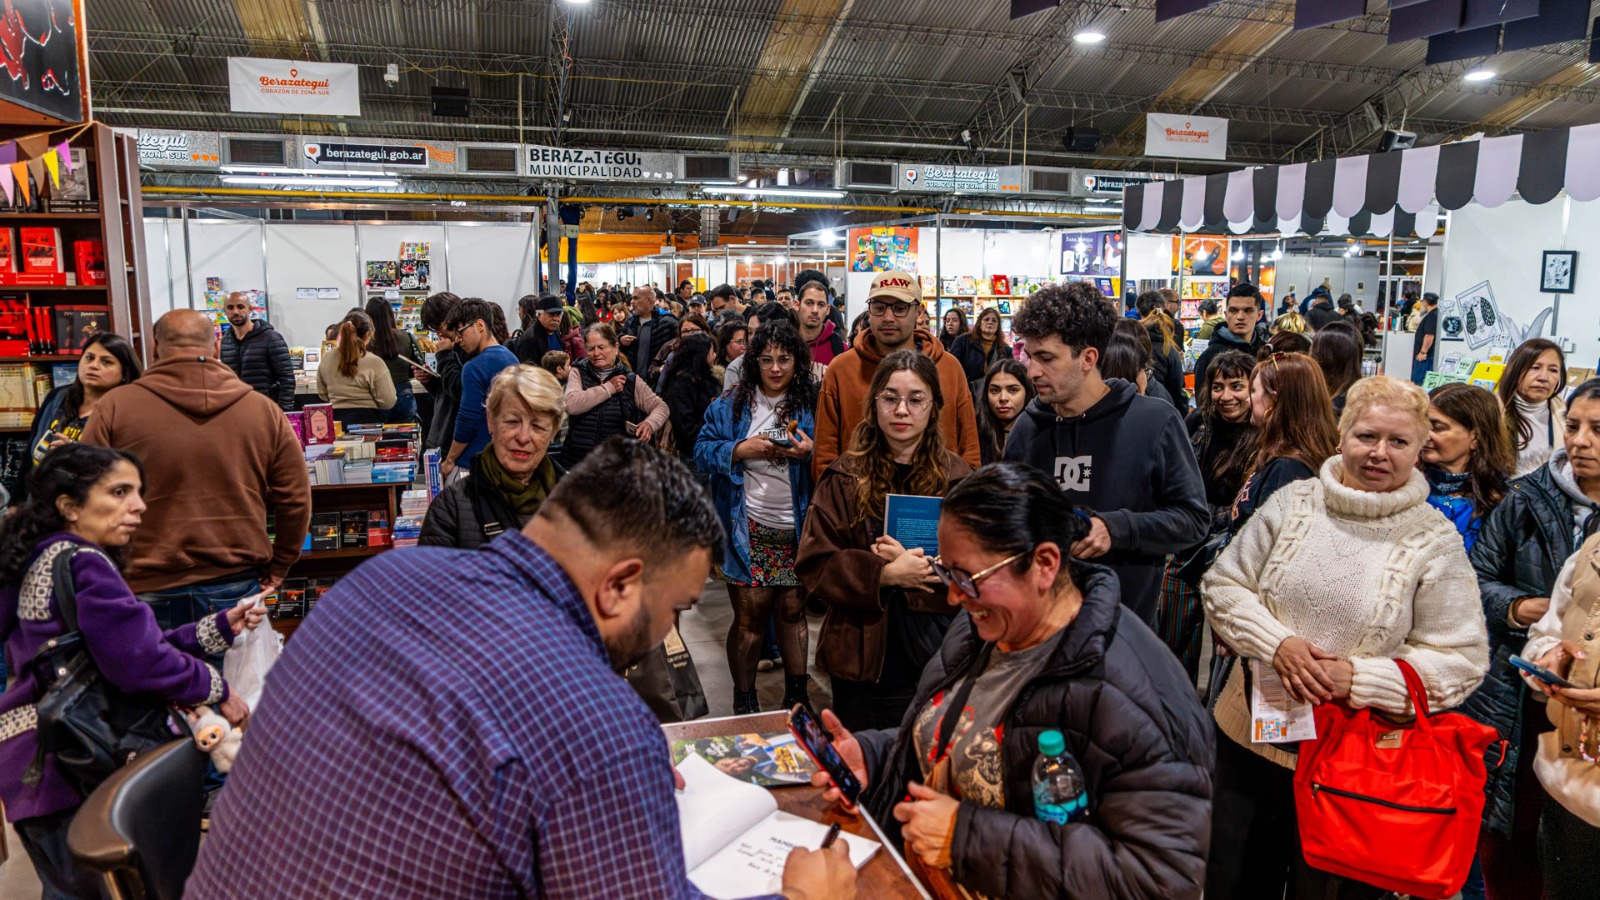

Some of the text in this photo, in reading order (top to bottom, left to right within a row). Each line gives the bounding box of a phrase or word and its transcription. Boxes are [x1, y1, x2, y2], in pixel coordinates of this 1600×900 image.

[260, 76, 329, 90] Berazategui
[1165, 127, 1209, 138] Berazategui
[142, 151, 188, 160] ZONA SUR
[326, 148, 423, 161] berazategui.gob.ar
[530, 164, 642, 178] MUNICIPALIDAD
[924, 166, 999, 184] Berazategui
[880, 277, 910, 288] RAW
